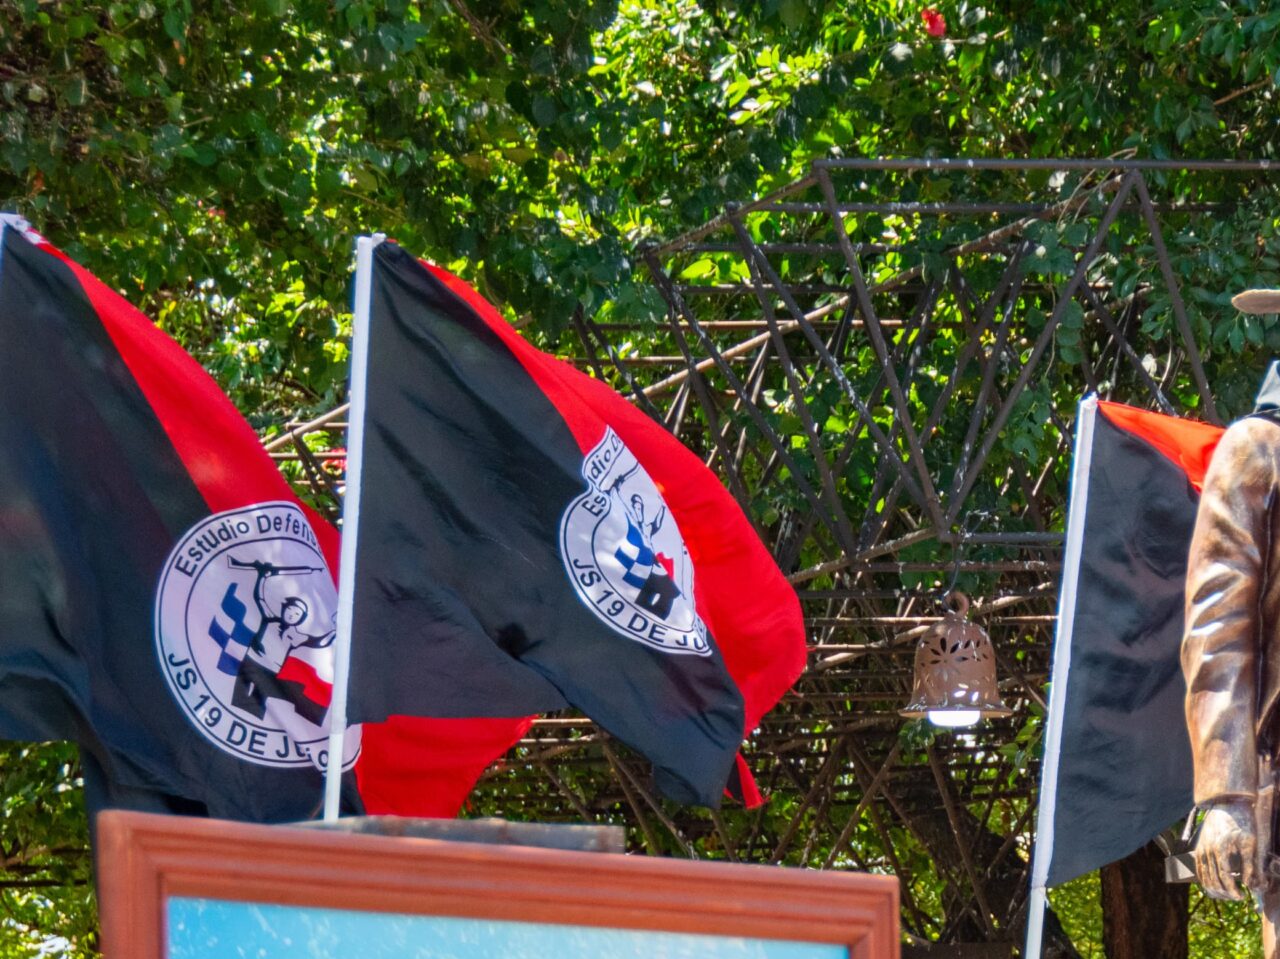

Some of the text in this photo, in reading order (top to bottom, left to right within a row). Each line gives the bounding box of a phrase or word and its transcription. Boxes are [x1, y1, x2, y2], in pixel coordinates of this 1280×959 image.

[573, 558, 602, 588] JS
[595, 589, 625, 616] 19
[627, 614, 668, 643] DE
[169, 652, 197, 690] JS
[193, 694, 222, 727] 19
[226, 724, 268, 755] DE
